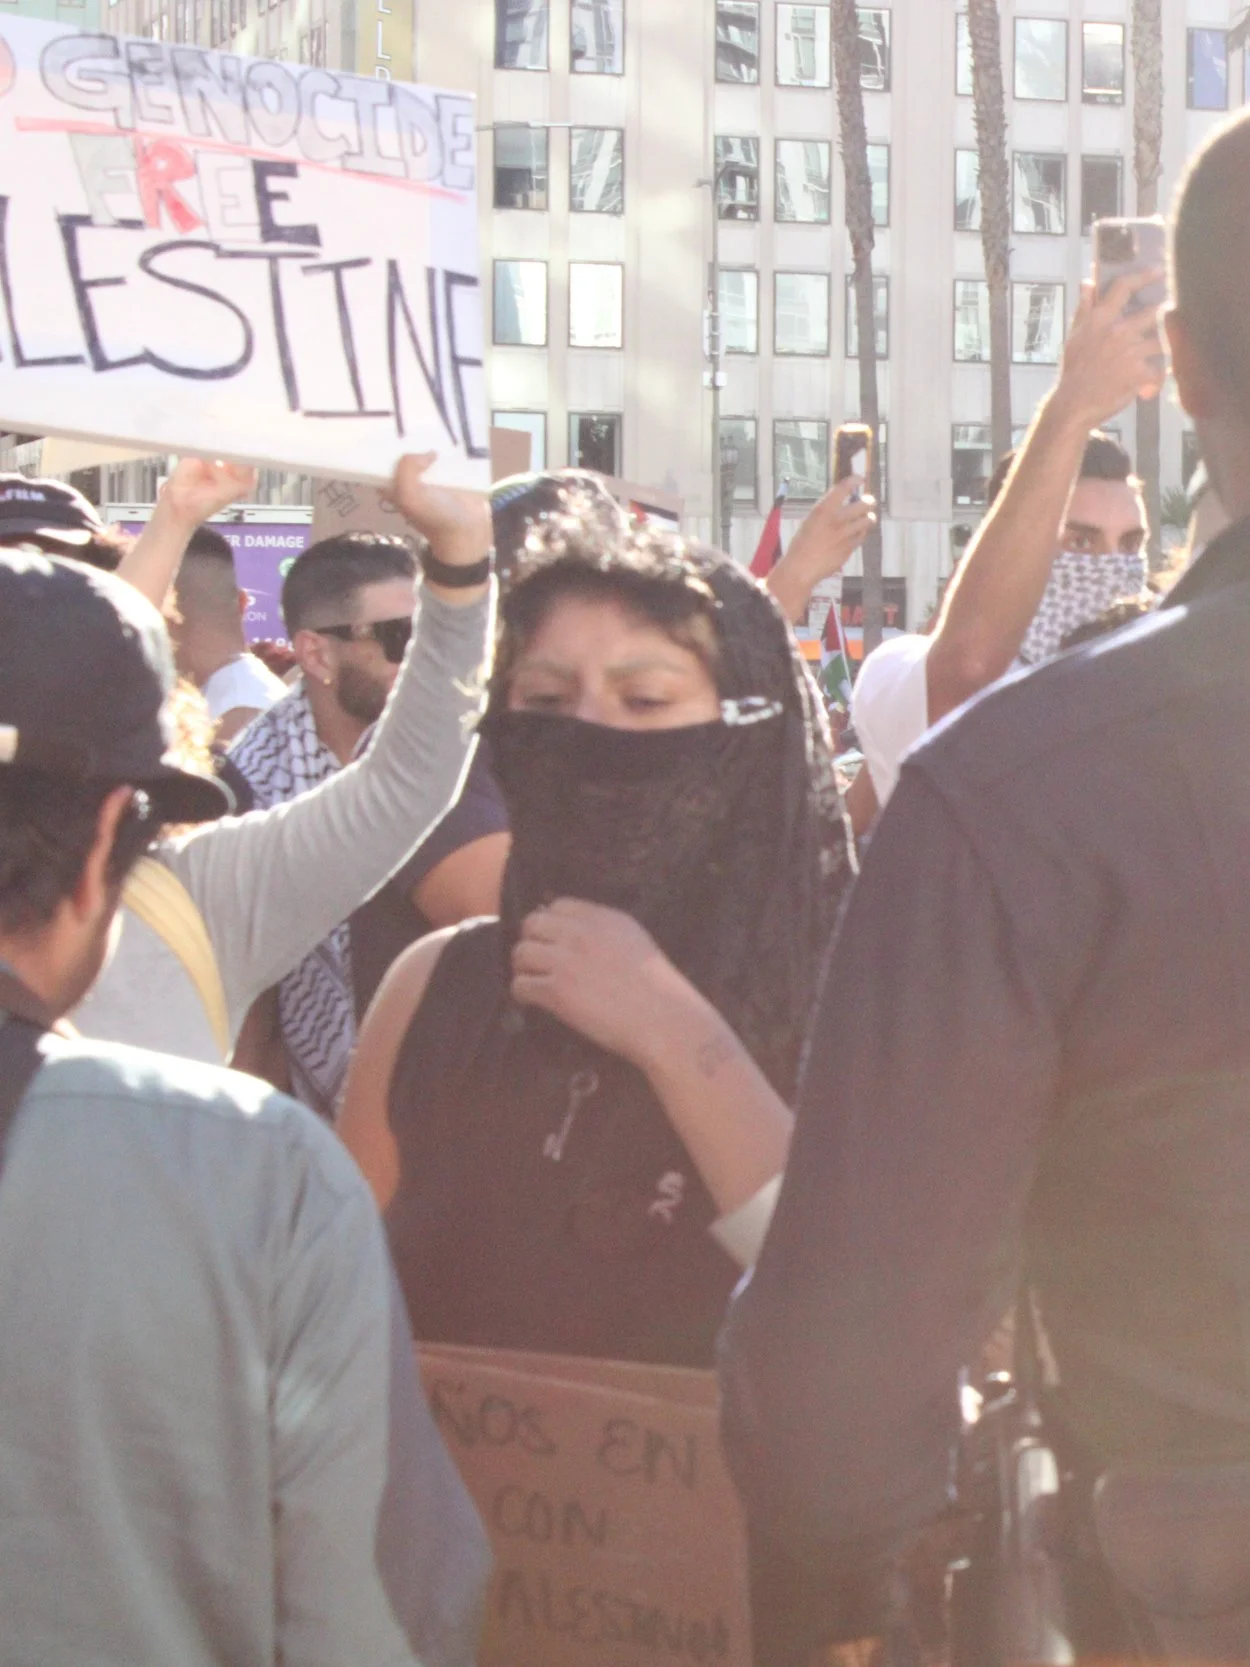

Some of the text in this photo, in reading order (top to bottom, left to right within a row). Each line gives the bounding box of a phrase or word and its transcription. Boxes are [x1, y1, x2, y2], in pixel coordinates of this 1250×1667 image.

[39, 33, 477, 191] GENOCIDE
[67, 129, 322, 248] FREE
[0, 193, 490, 460] LESTINE
[244, 535, 304, 549] DAMAGE
